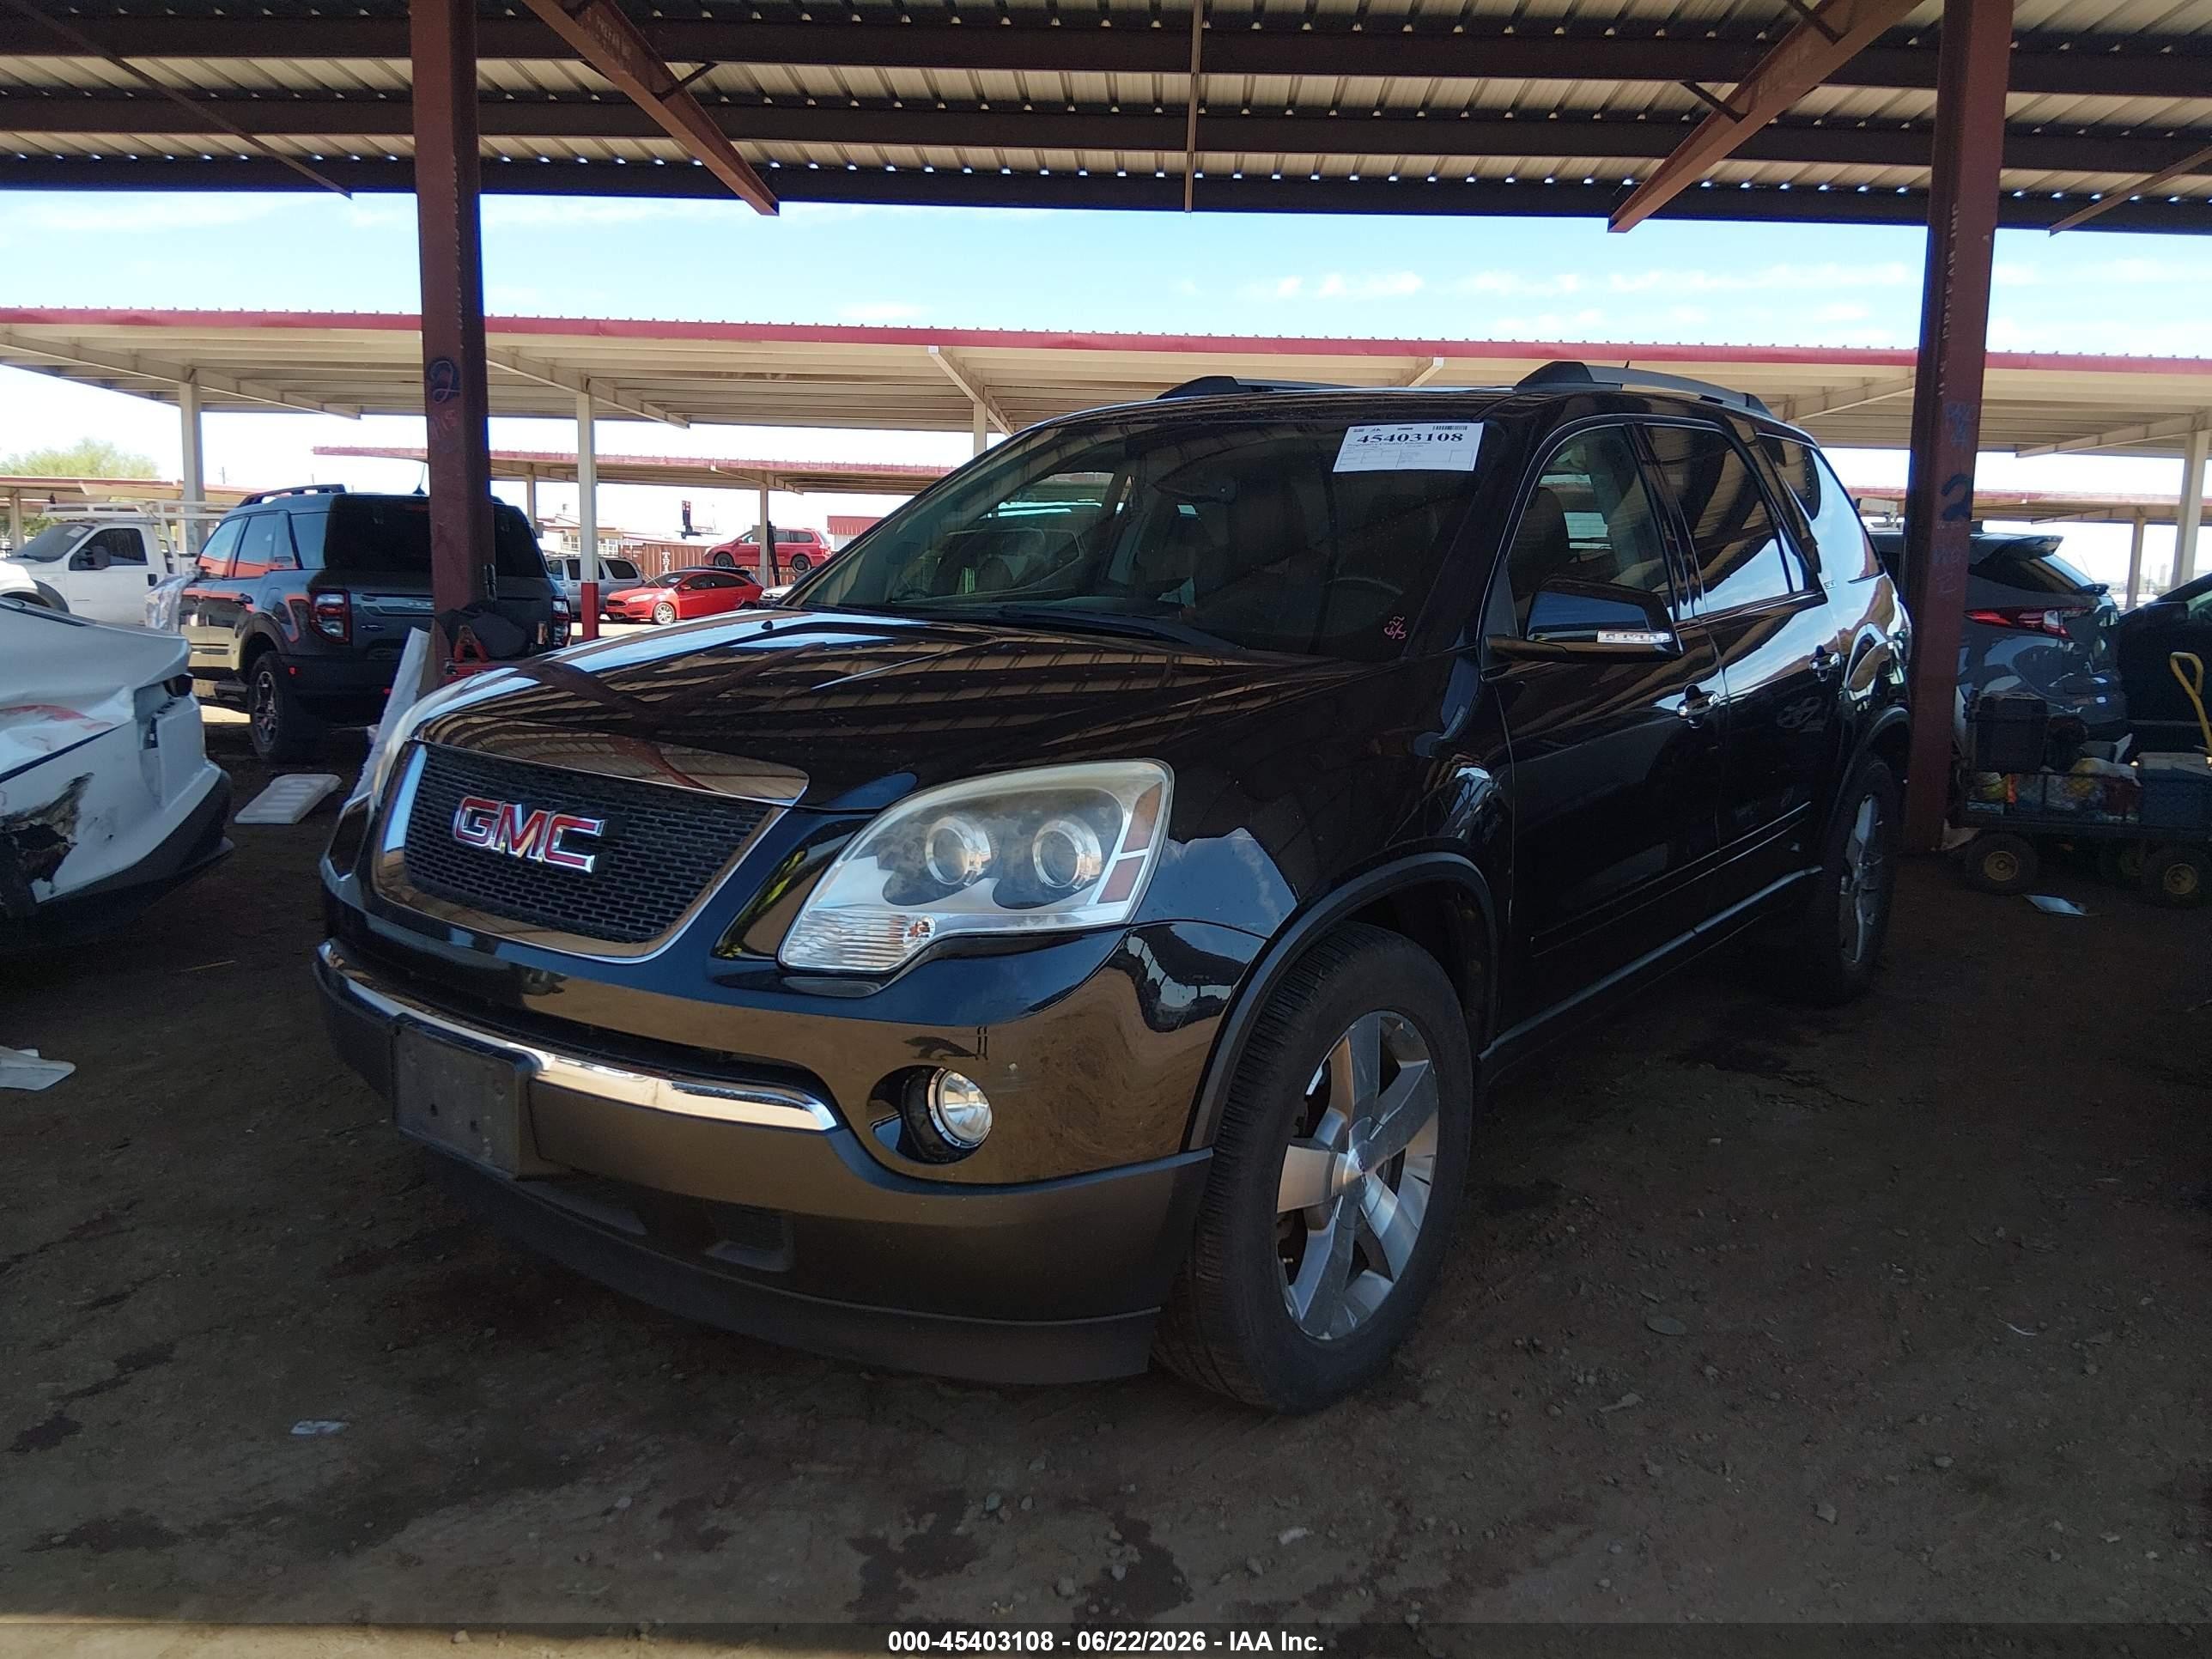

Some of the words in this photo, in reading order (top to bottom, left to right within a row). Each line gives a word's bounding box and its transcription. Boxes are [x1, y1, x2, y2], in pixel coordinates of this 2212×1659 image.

[1356, 433, 1464, 444] 45403108
[1942, 473, 1972, 521] 2
[453, 796, 608, 873] GMC
